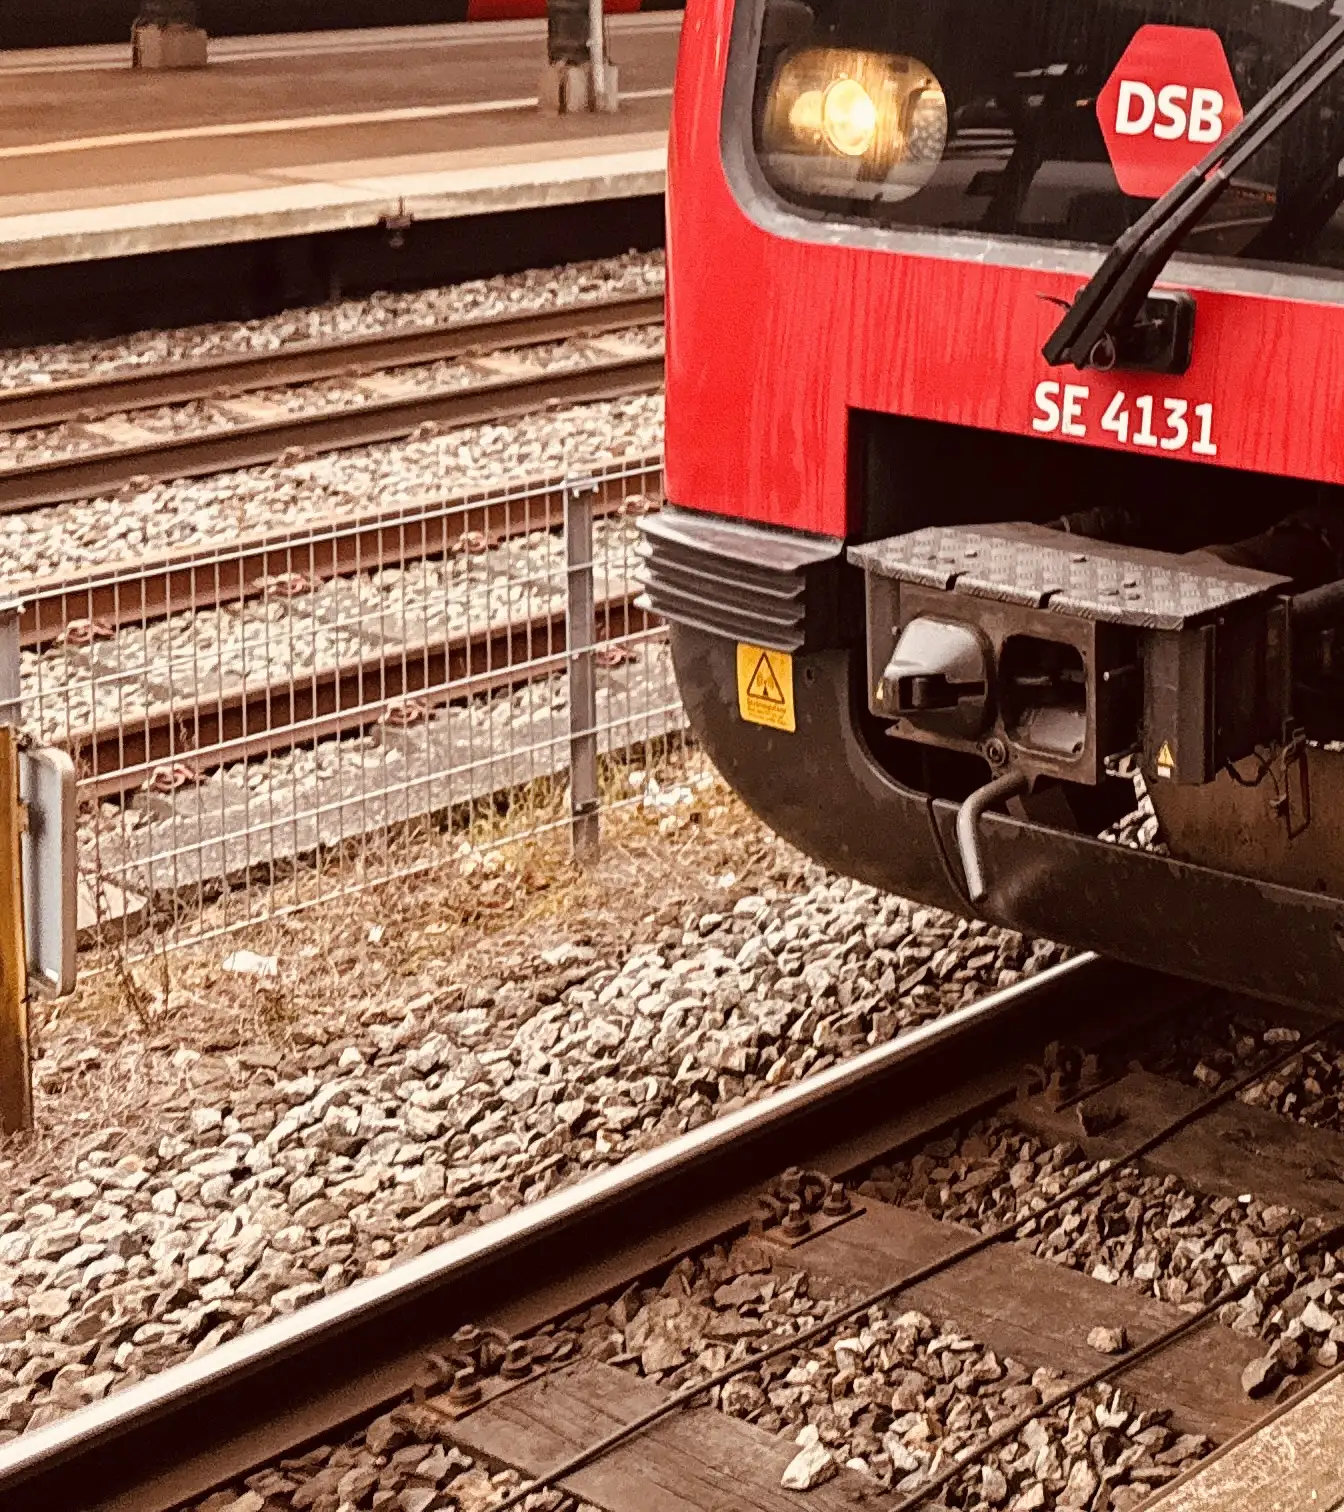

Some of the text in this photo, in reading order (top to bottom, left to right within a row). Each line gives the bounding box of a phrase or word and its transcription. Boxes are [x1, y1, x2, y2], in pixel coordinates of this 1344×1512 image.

[1115, 79, 1224, 144] DSB
[1032, 380, 1218, 456] SE 4131
